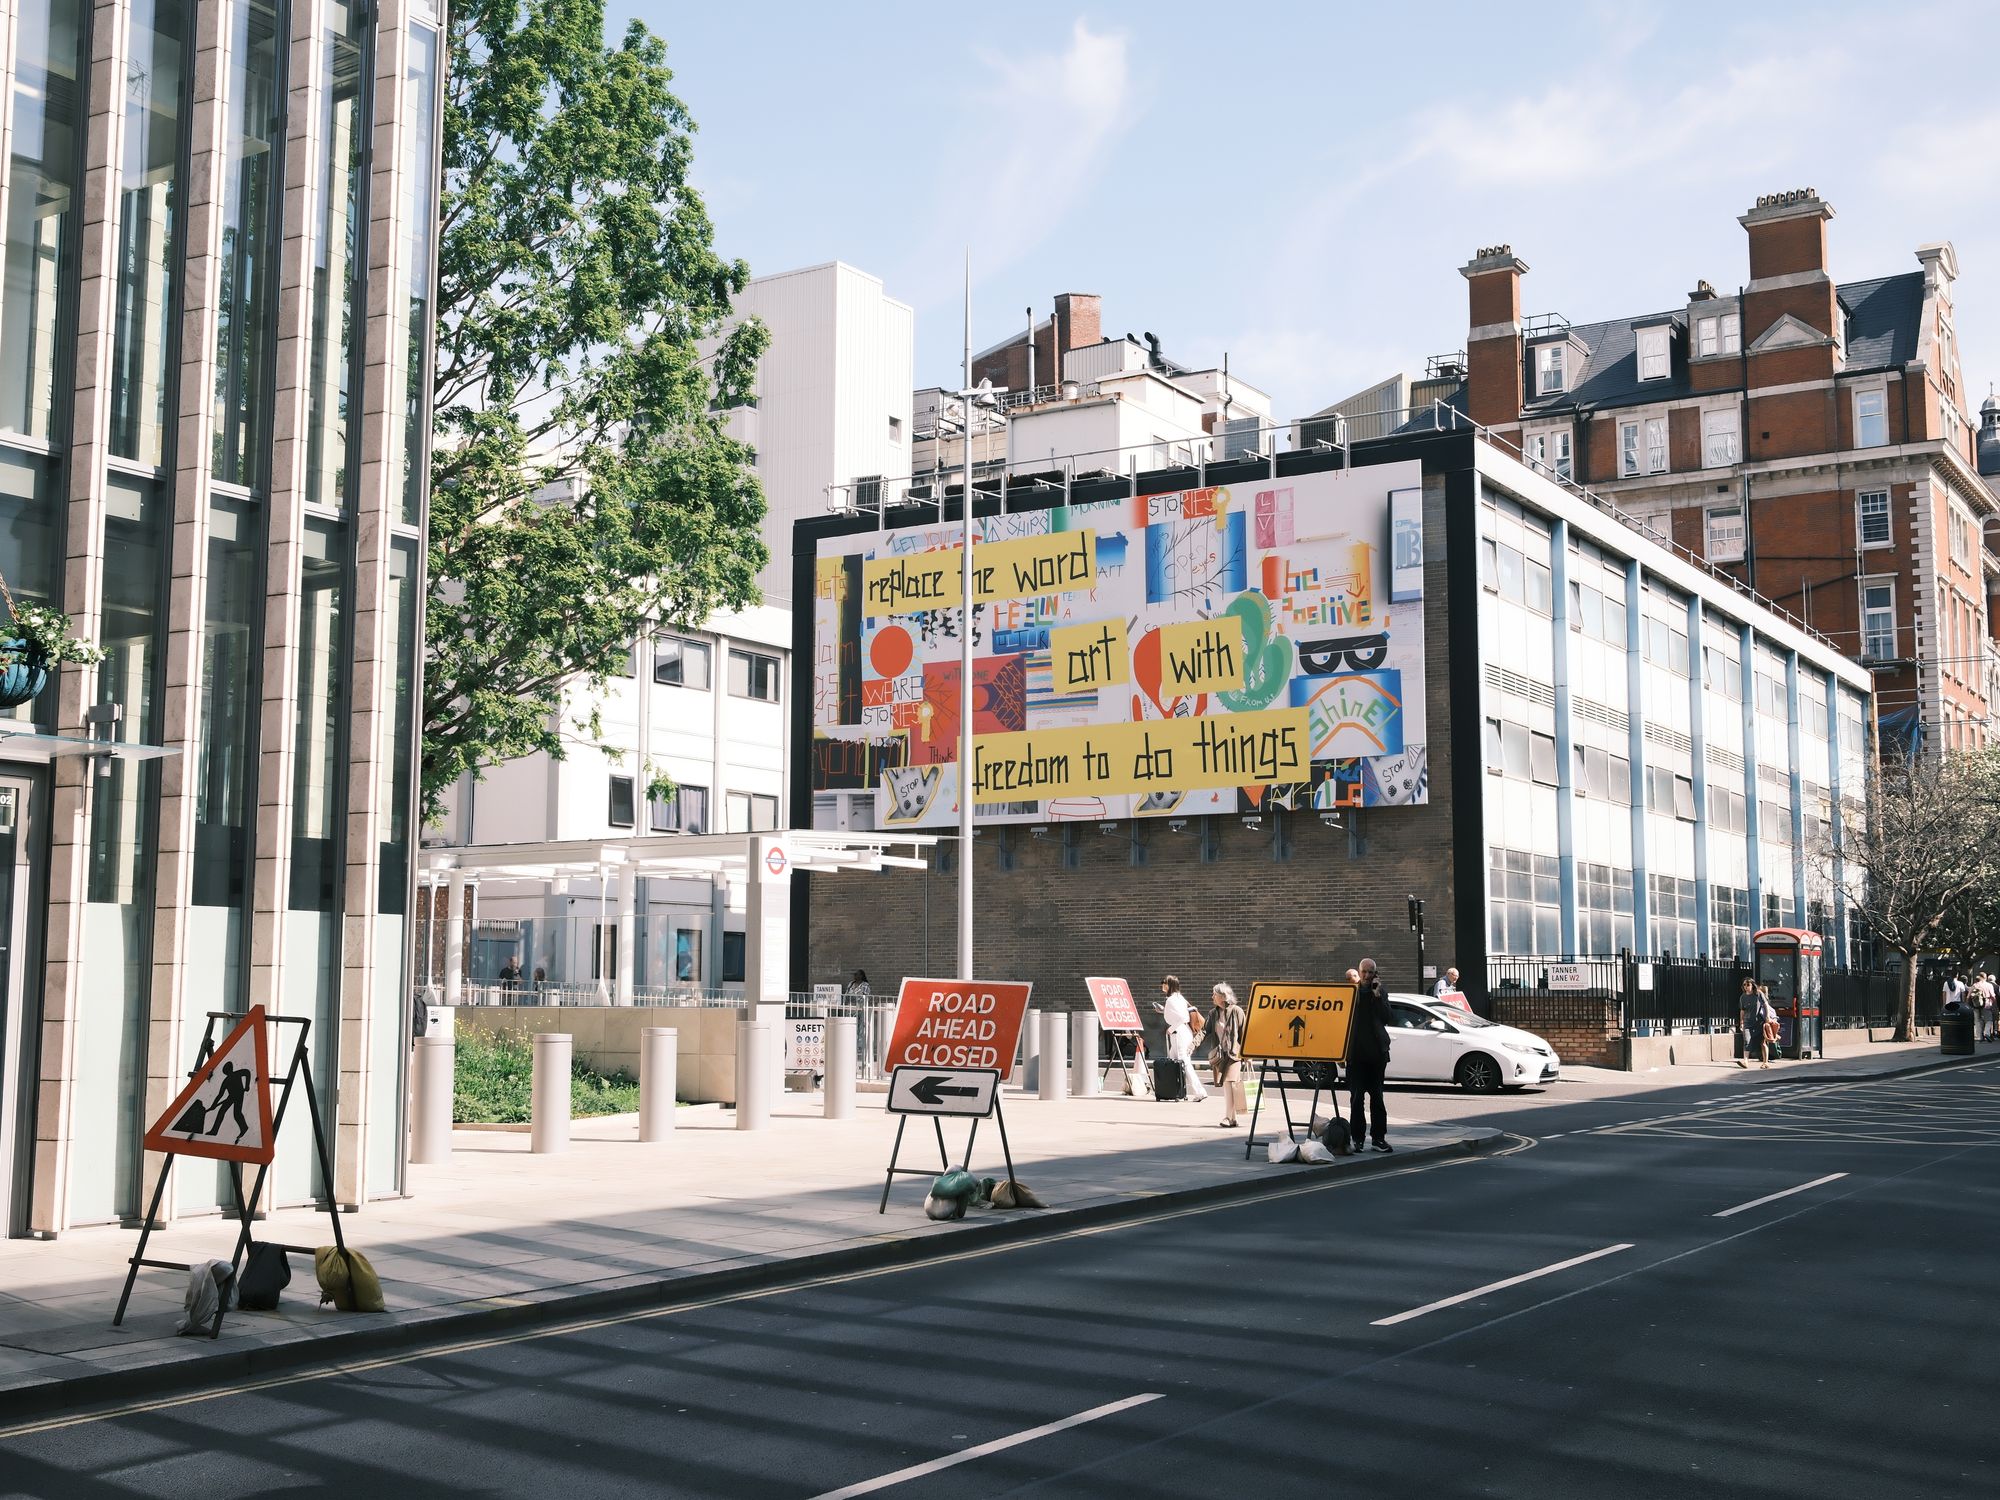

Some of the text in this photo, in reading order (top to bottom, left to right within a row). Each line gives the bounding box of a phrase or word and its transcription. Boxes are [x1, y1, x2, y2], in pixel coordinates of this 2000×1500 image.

[869, 531, 1089, 607] replace the word
[1068, 625, 1235, 684] art with
[971, 720, 1299, 796] freedom to do things
[1382, 760, 1405, 783] STOP
[901, 777, 919, 798] STOP
[1551, 966, 1578, 974] TANNER
[1551, 974, 1580, 982] LANE W2
[1100, 984, 1124, 996] ROAD
[928, 991, 996, 1015] ROAD
[1104, 997, 1130, 1009] AHEAD
[1257, 993, 1345, 1012] Diversion
[1105, 1010, 1137, 1023] CLOSED
[916, 1017, 997, 1041] AHEAD
[904, 1042, 998, 1068] CLOSED
